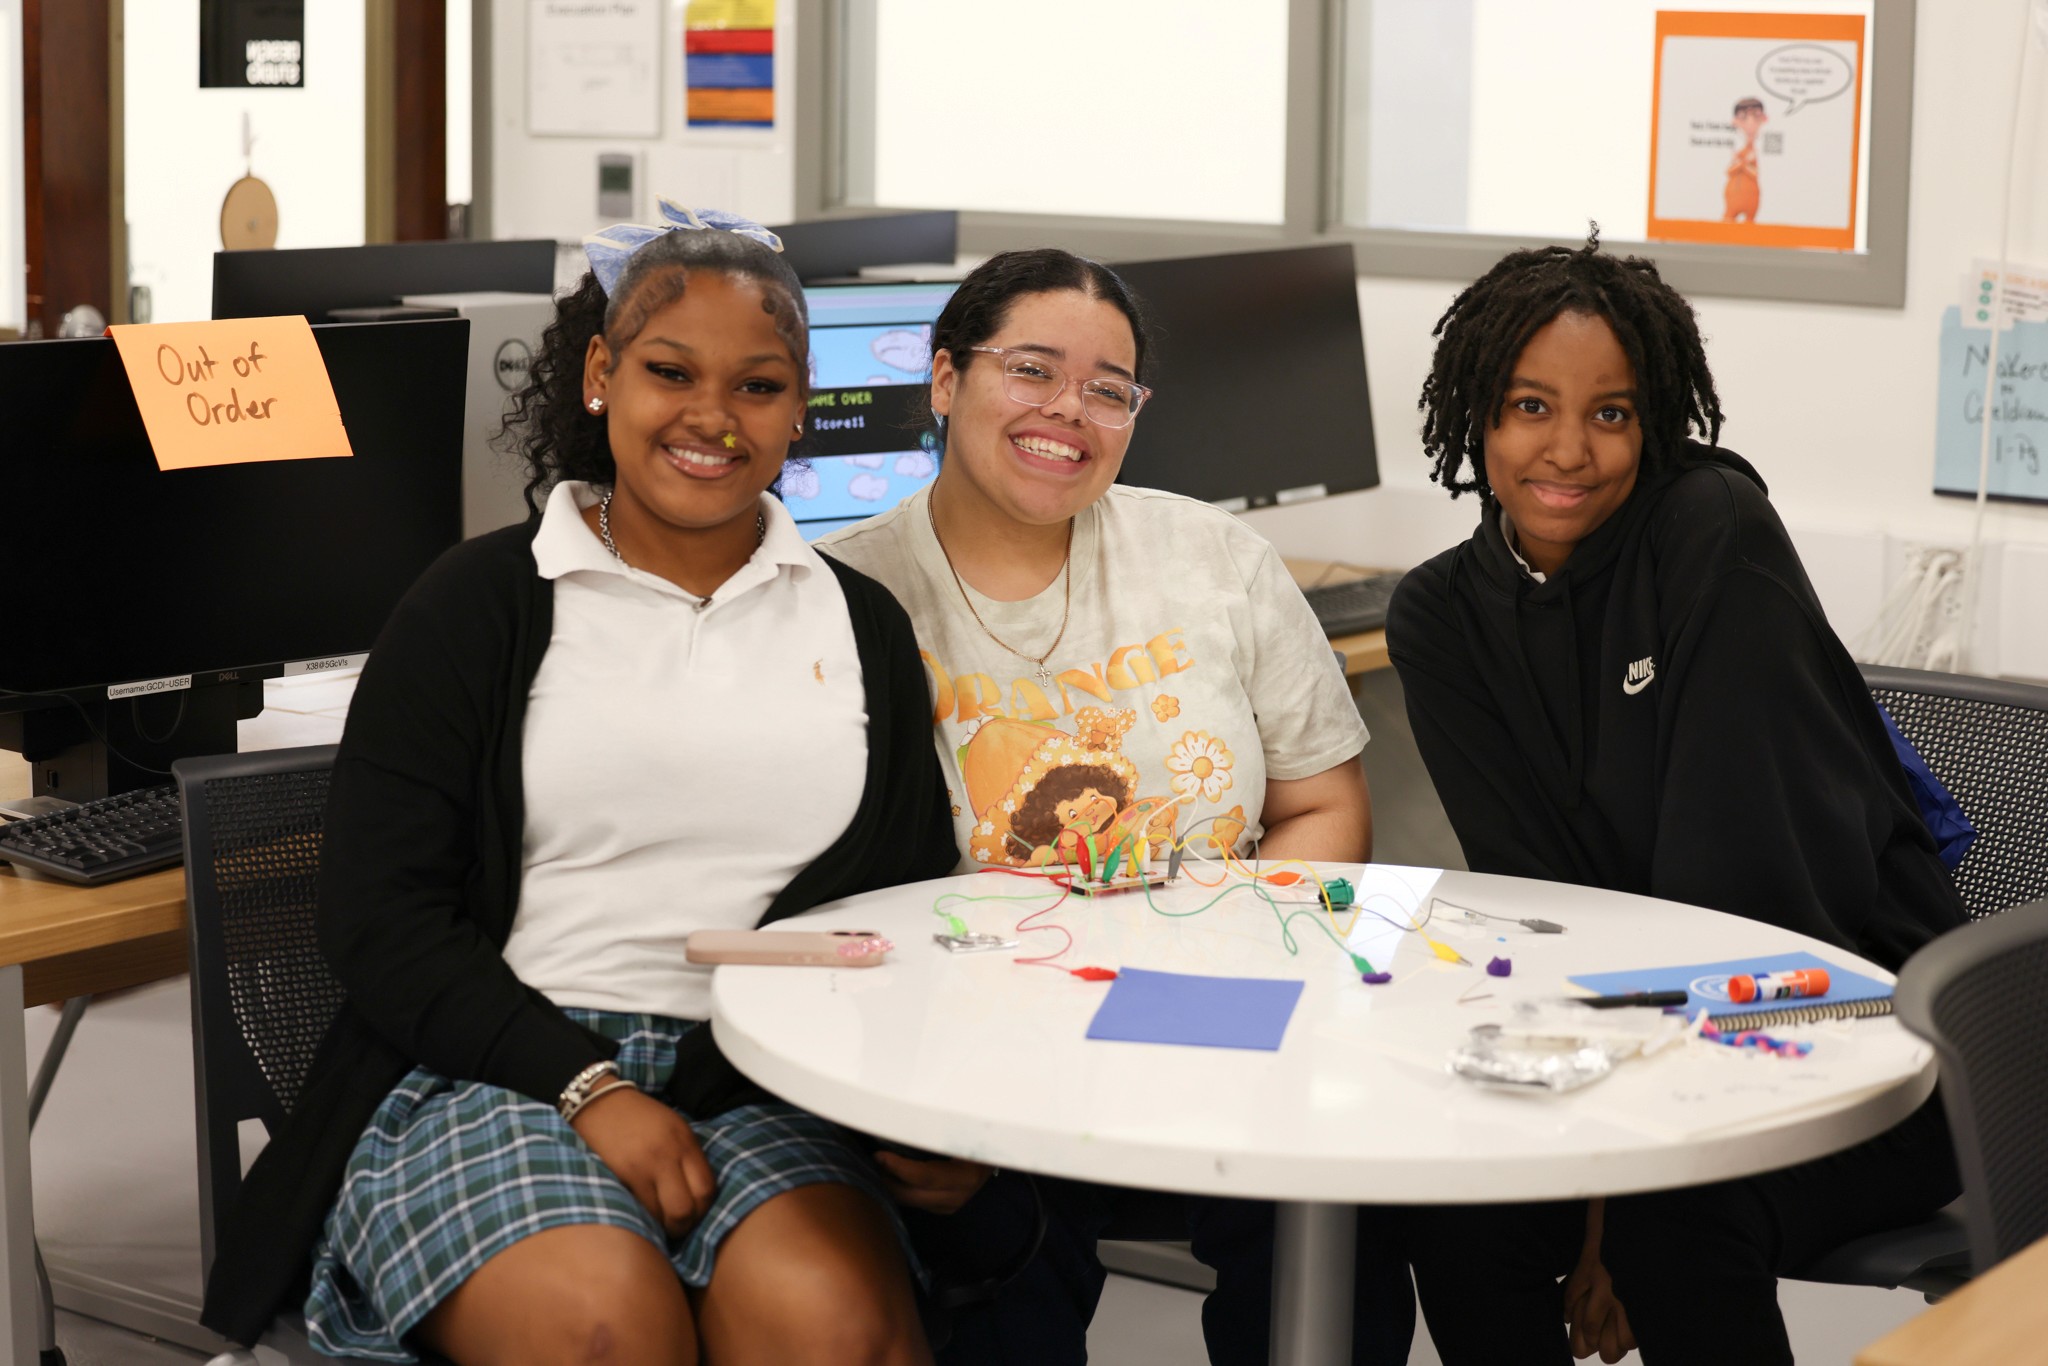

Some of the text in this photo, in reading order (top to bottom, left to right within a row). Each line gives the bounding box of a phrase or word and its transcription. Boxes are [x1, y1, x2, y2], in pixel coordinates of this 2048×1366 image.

[157, 341, 267, 385] Out of
[187, 387, 278, 426] Order
[841, 391, 873, 406] OVER
[219, 671, 240, 682] DELL
